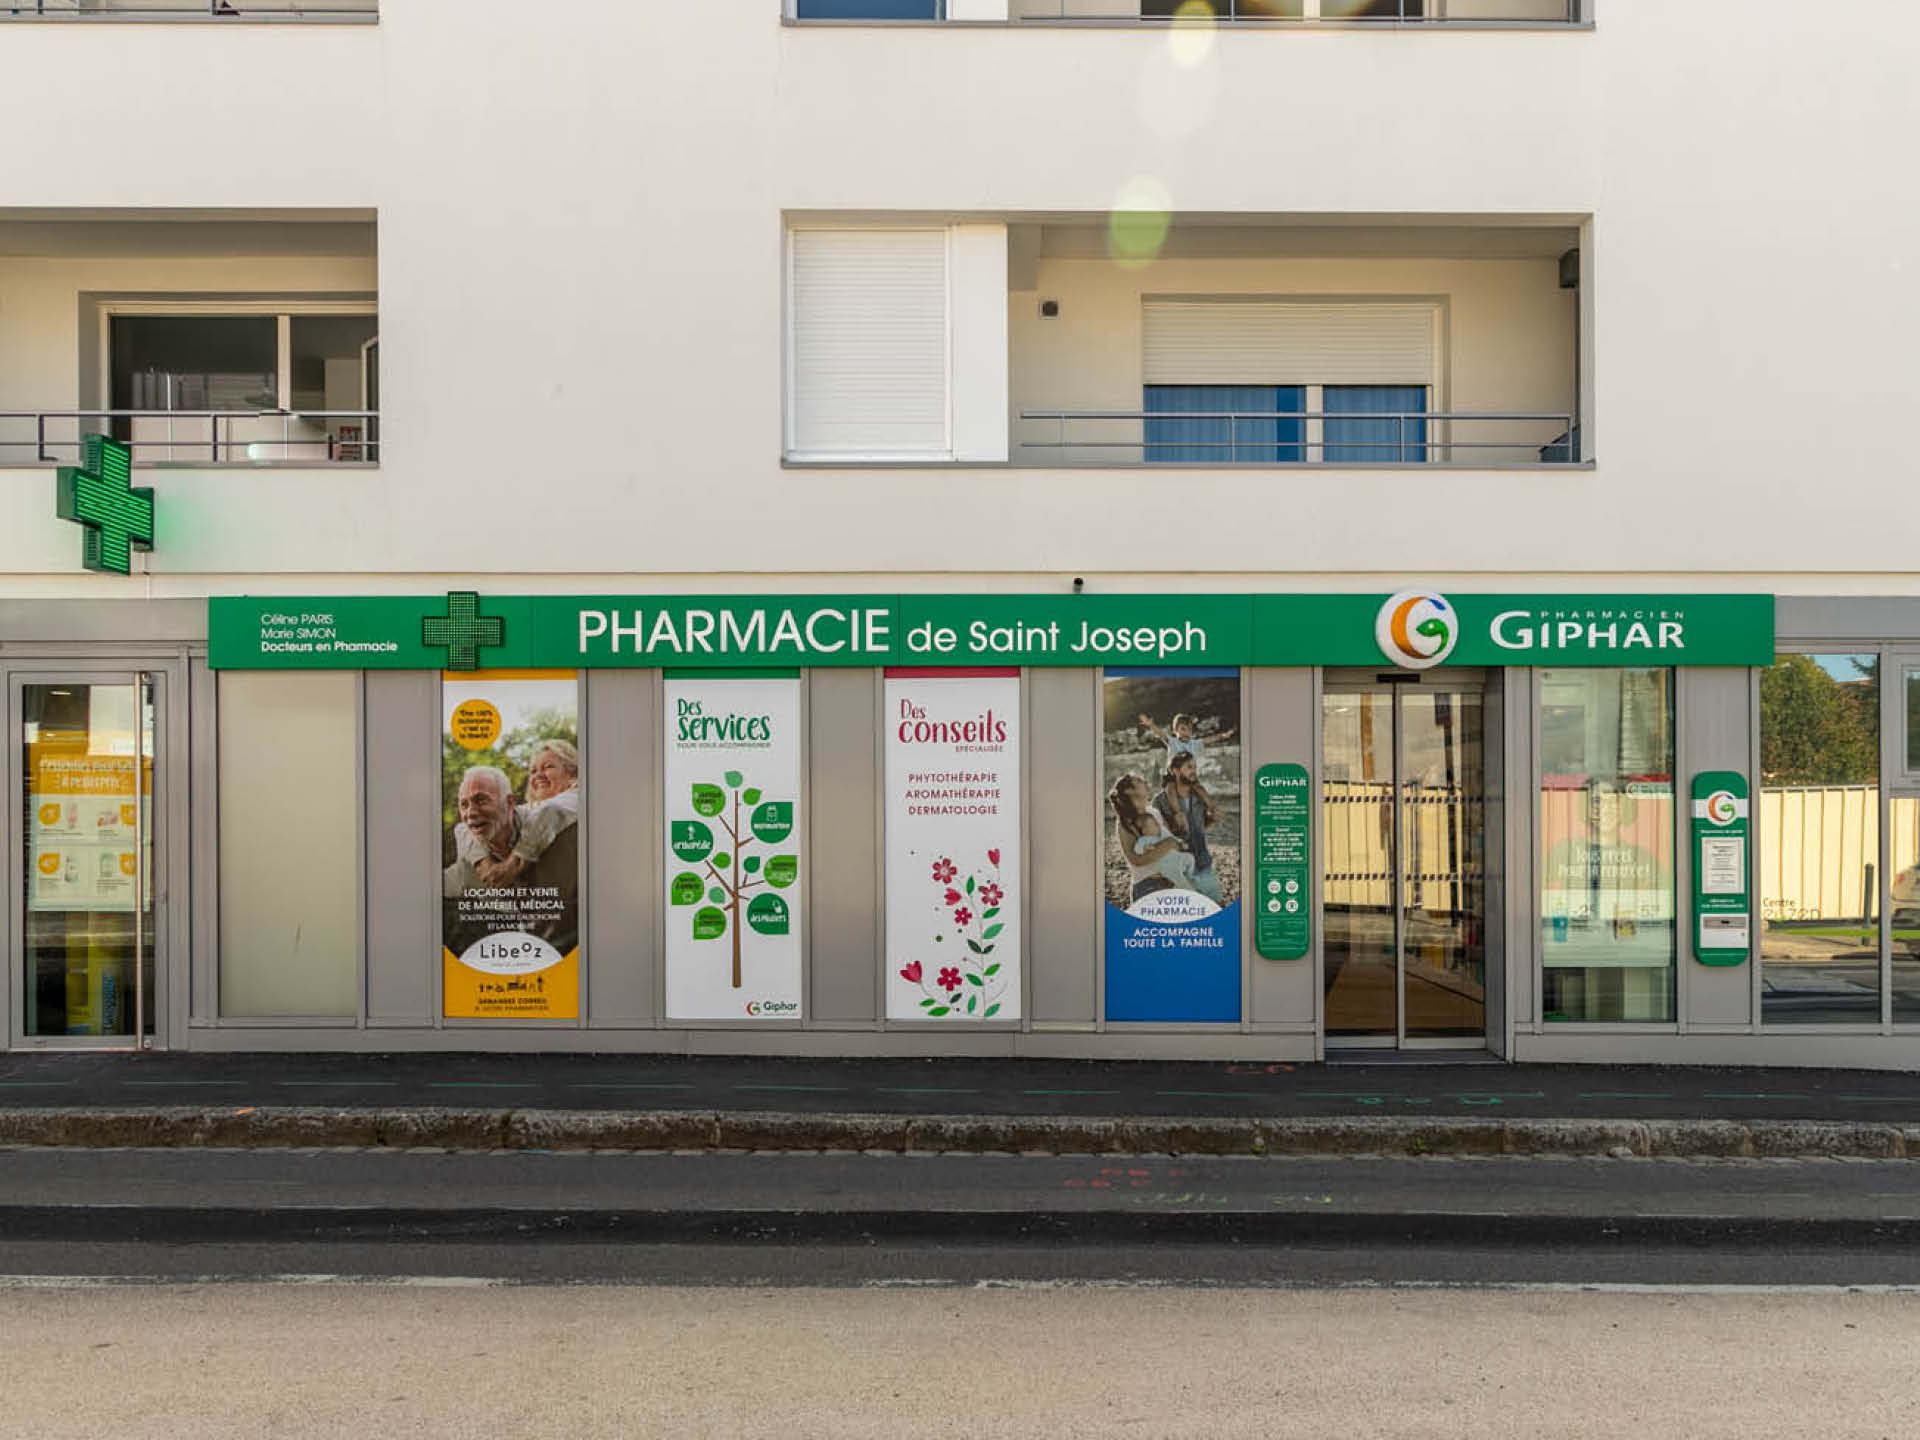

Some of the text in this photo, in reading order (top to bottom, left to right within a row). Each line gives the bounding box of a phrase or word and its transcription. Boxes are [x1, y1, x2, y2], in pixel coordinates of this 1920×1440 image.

[261, 614, 333, 625] Céline PARIS
[1541, 610, 1685, 620] PHARMACIEN
[261, 628, 336, 639] Marie SIMON
[579, 609, 1207, 659] PHARMACIE de Saint Joseph
[1489, 609, 1685, 650] GIPHAR
[261, 641, 398, 653] Docteurs en Pharmacie
[678, 698, 702, 716] Des
[900, 698, 926, 719] Des
[908, 772, 998, 783] PHYTOTHÉRAPIE
[1259, 776, 1306, 787] GIPHAR
[905, 788, 1001, 799] AROMATHÉRAPIE
[908, 805, 998, 815] DERMATOLOGIE
[464, 887, 560, 898] LOCATION ET VENTE
[458, 898, 565, 911] DE MATÉRIEL MÉDICAL
[1156, 896, 1190, 906] VOTRE
[1140, 907, 1206, 916] PHARMACIE
[1133, 927, 1214, 937] ACCOMPAGNE
[1123, 939, 1224, 948] TOUTE LA FAMILLE
[763, 1001, 797, 1013] Giphar
